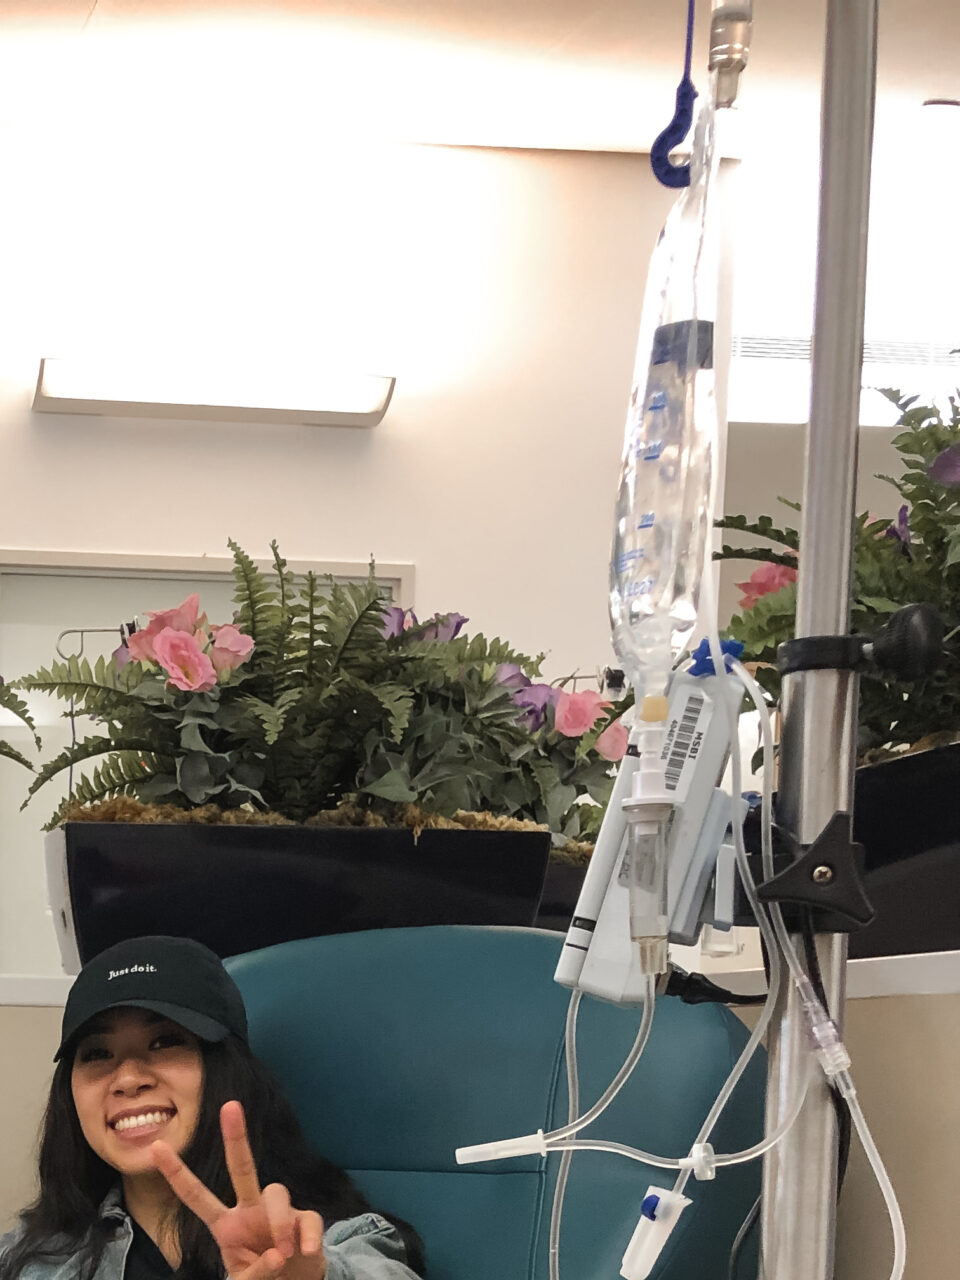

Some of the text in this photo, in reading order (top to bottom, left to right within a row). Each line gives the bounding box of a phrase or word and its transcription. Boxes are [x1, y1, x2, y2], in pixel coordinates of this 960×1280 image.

[688, 731, 704, 760] MSBI
[107, 963, 157, 980] Just do it.
